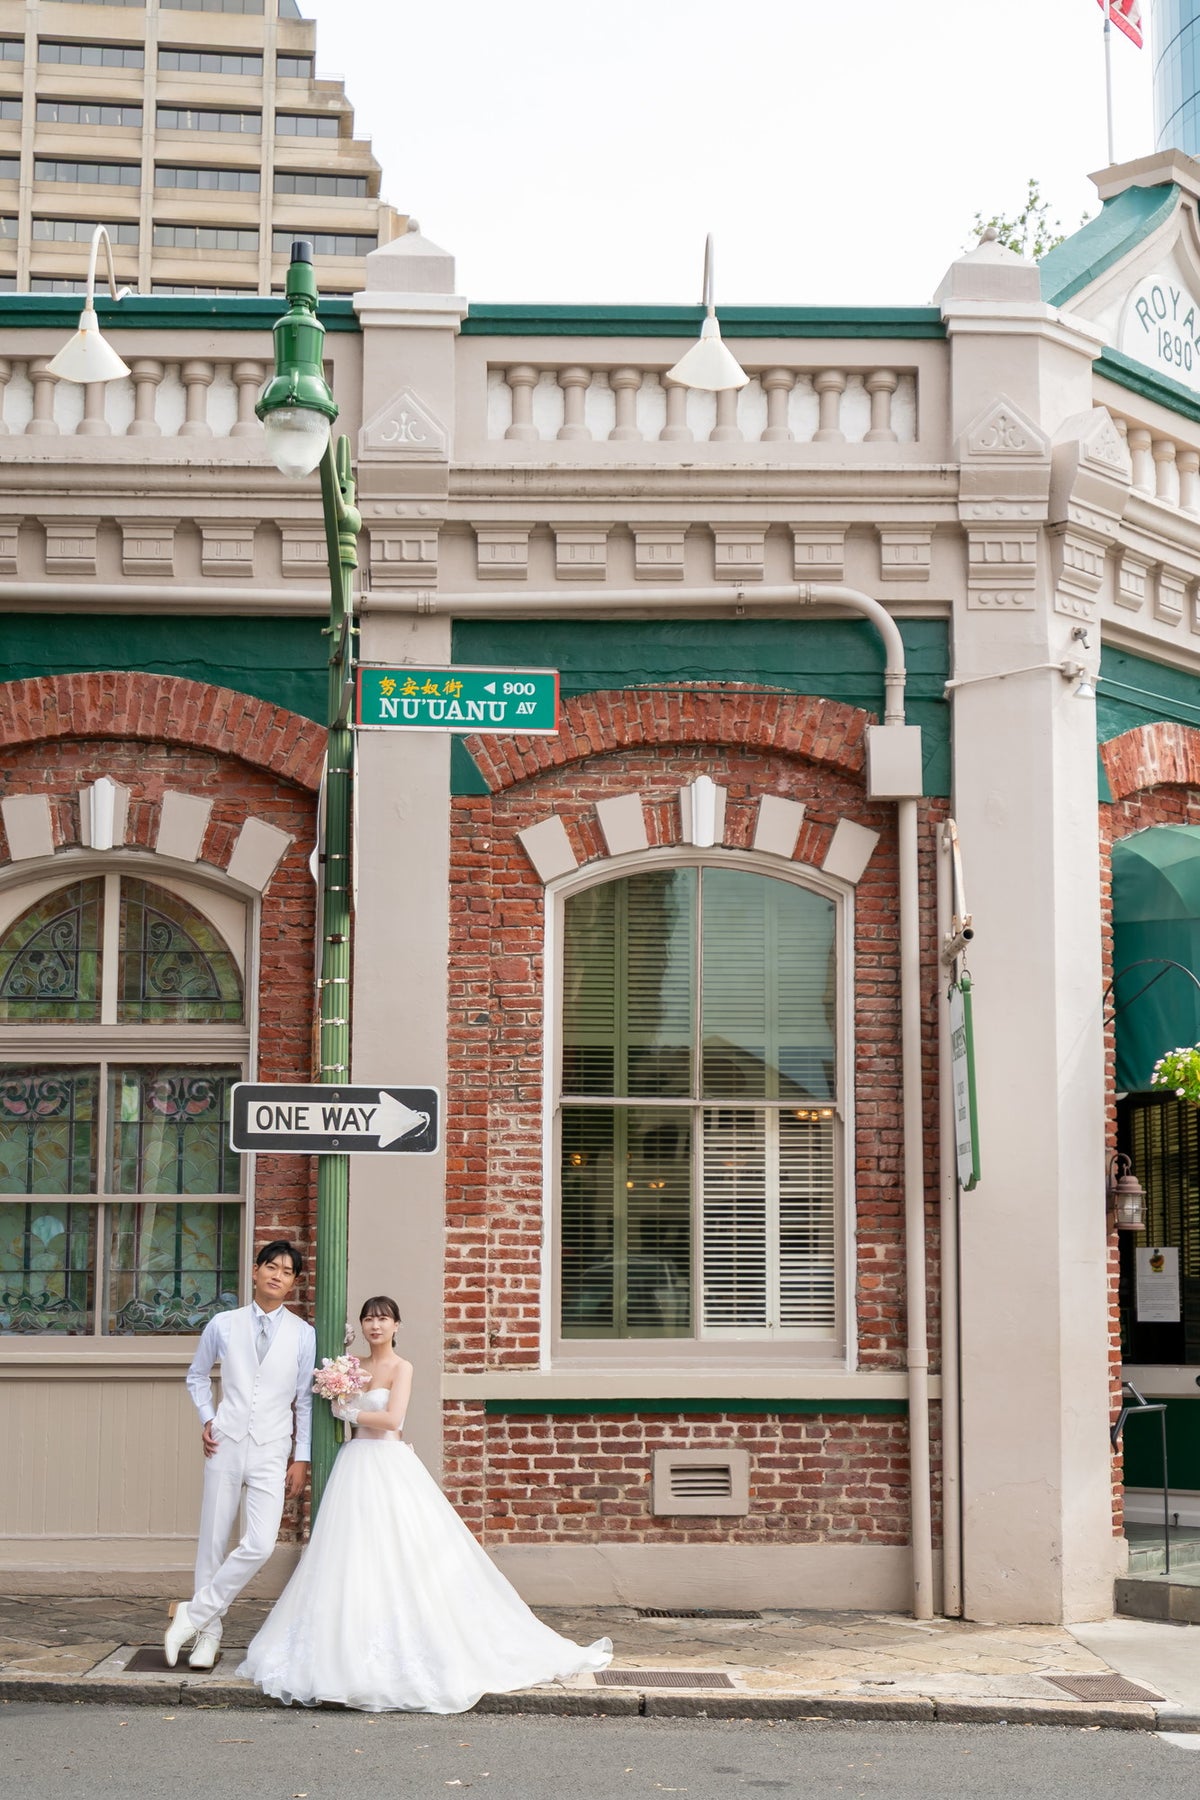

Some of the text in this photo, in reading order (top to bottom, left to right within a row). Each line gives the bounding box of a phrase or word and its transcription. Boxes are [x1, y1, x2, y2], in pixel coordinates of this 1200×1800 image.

[1158, 327, 1192, 371] 1890
[378, 676, 463, 698] 努安奴街
[503, 682, 536, 695] 900
[379, 698, 537, 721] NU'UANU AV
[256, 1105, 377, 1132] ONE WAY
